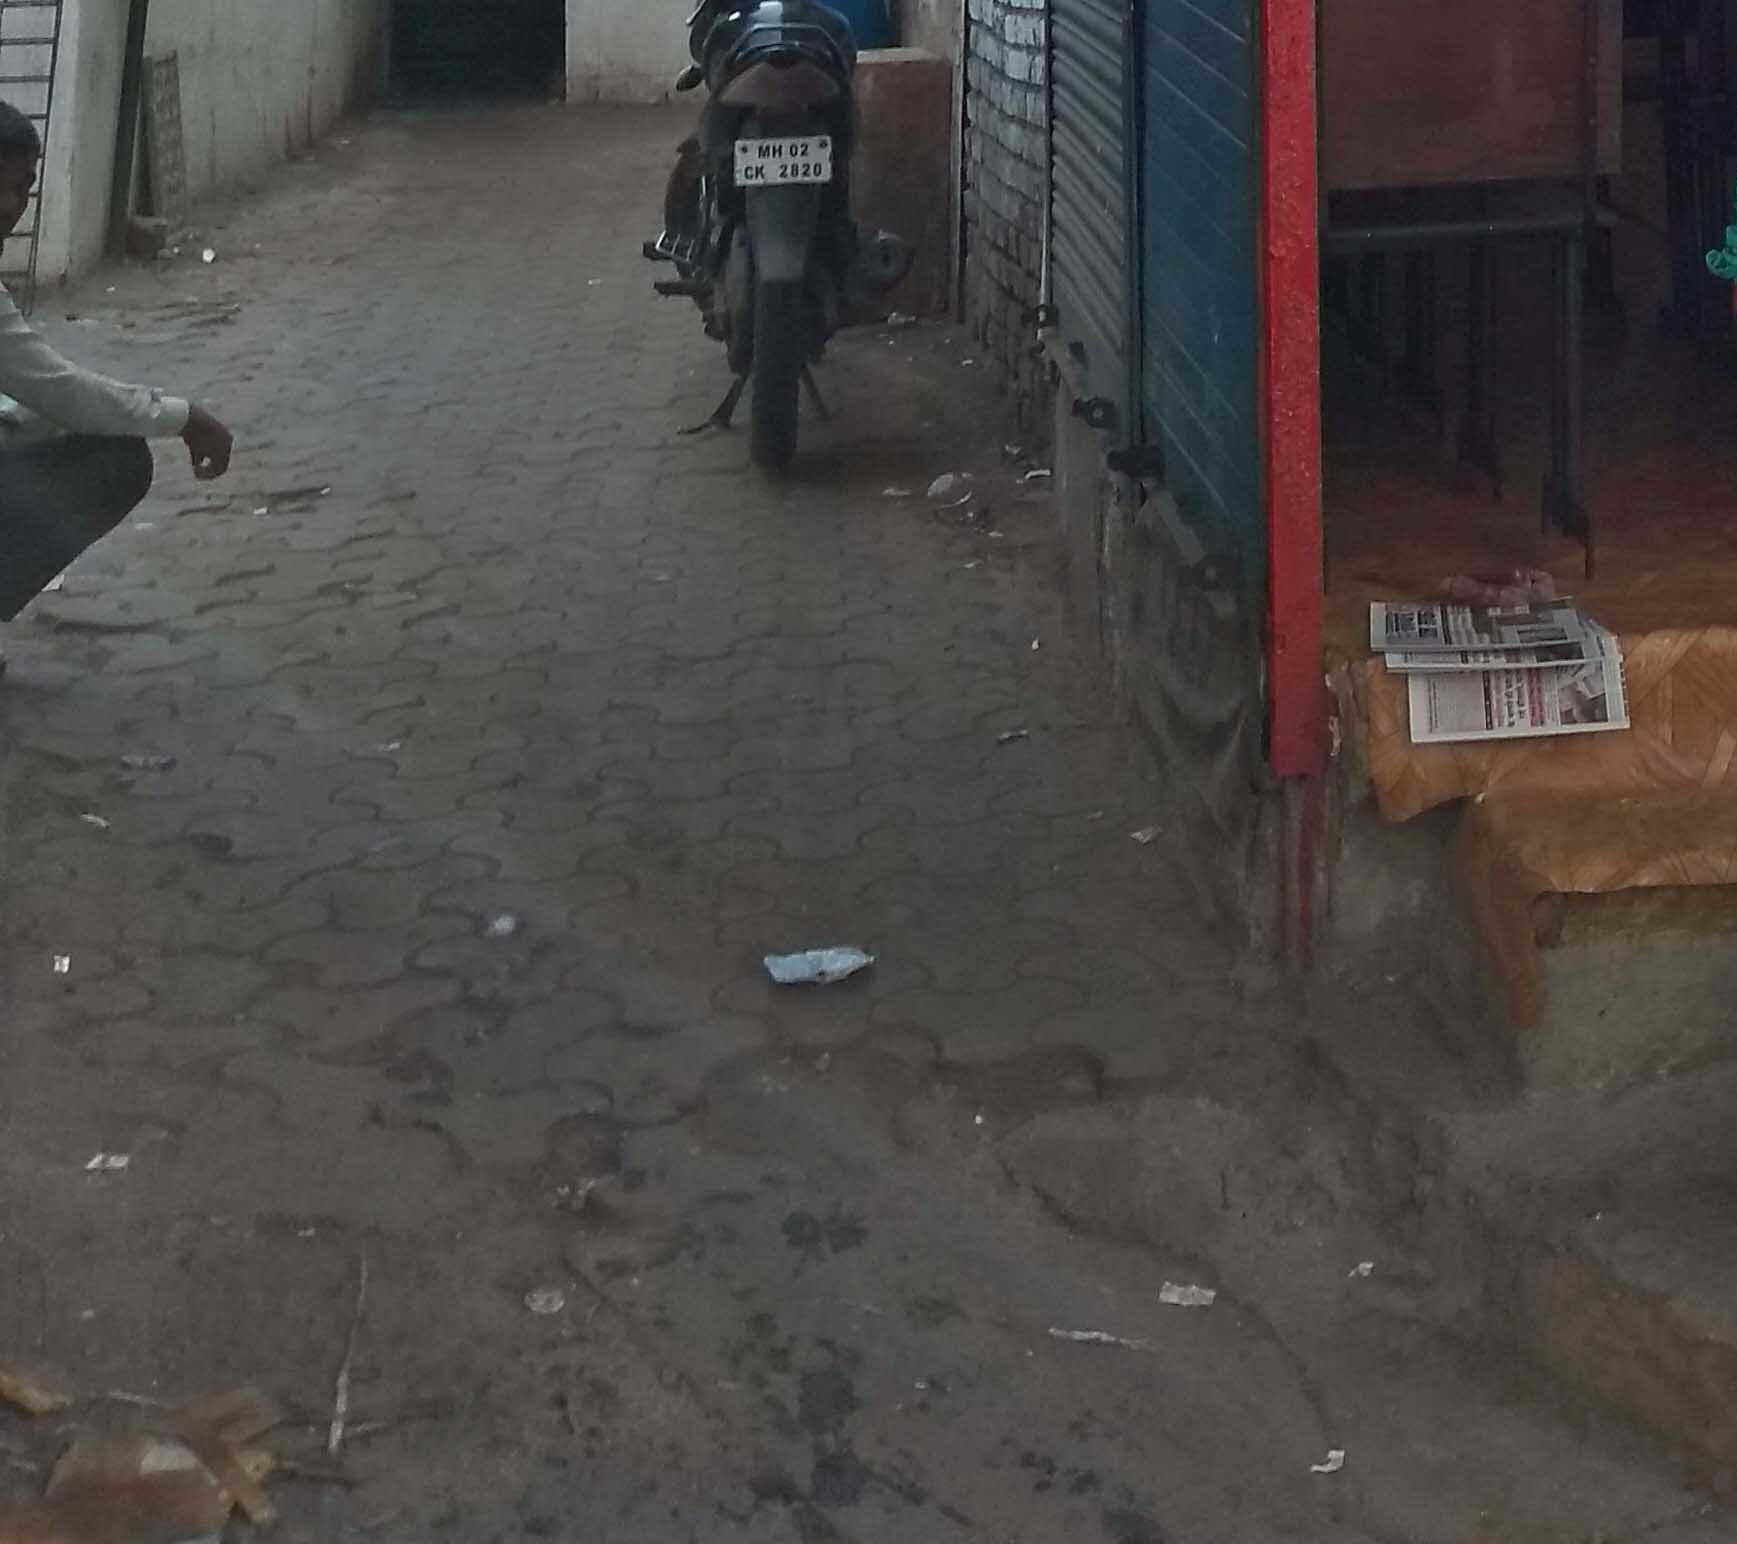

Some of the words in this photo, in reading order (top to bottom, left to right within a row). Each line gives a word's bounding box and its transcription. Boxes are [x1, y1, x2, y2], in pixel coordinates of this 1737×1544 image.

[757, 144, 783, 159] MH
[789, 143, 809, 158] 02
[743, 165, 765, 180] CK
[779, 163, 823, 179] 2820
